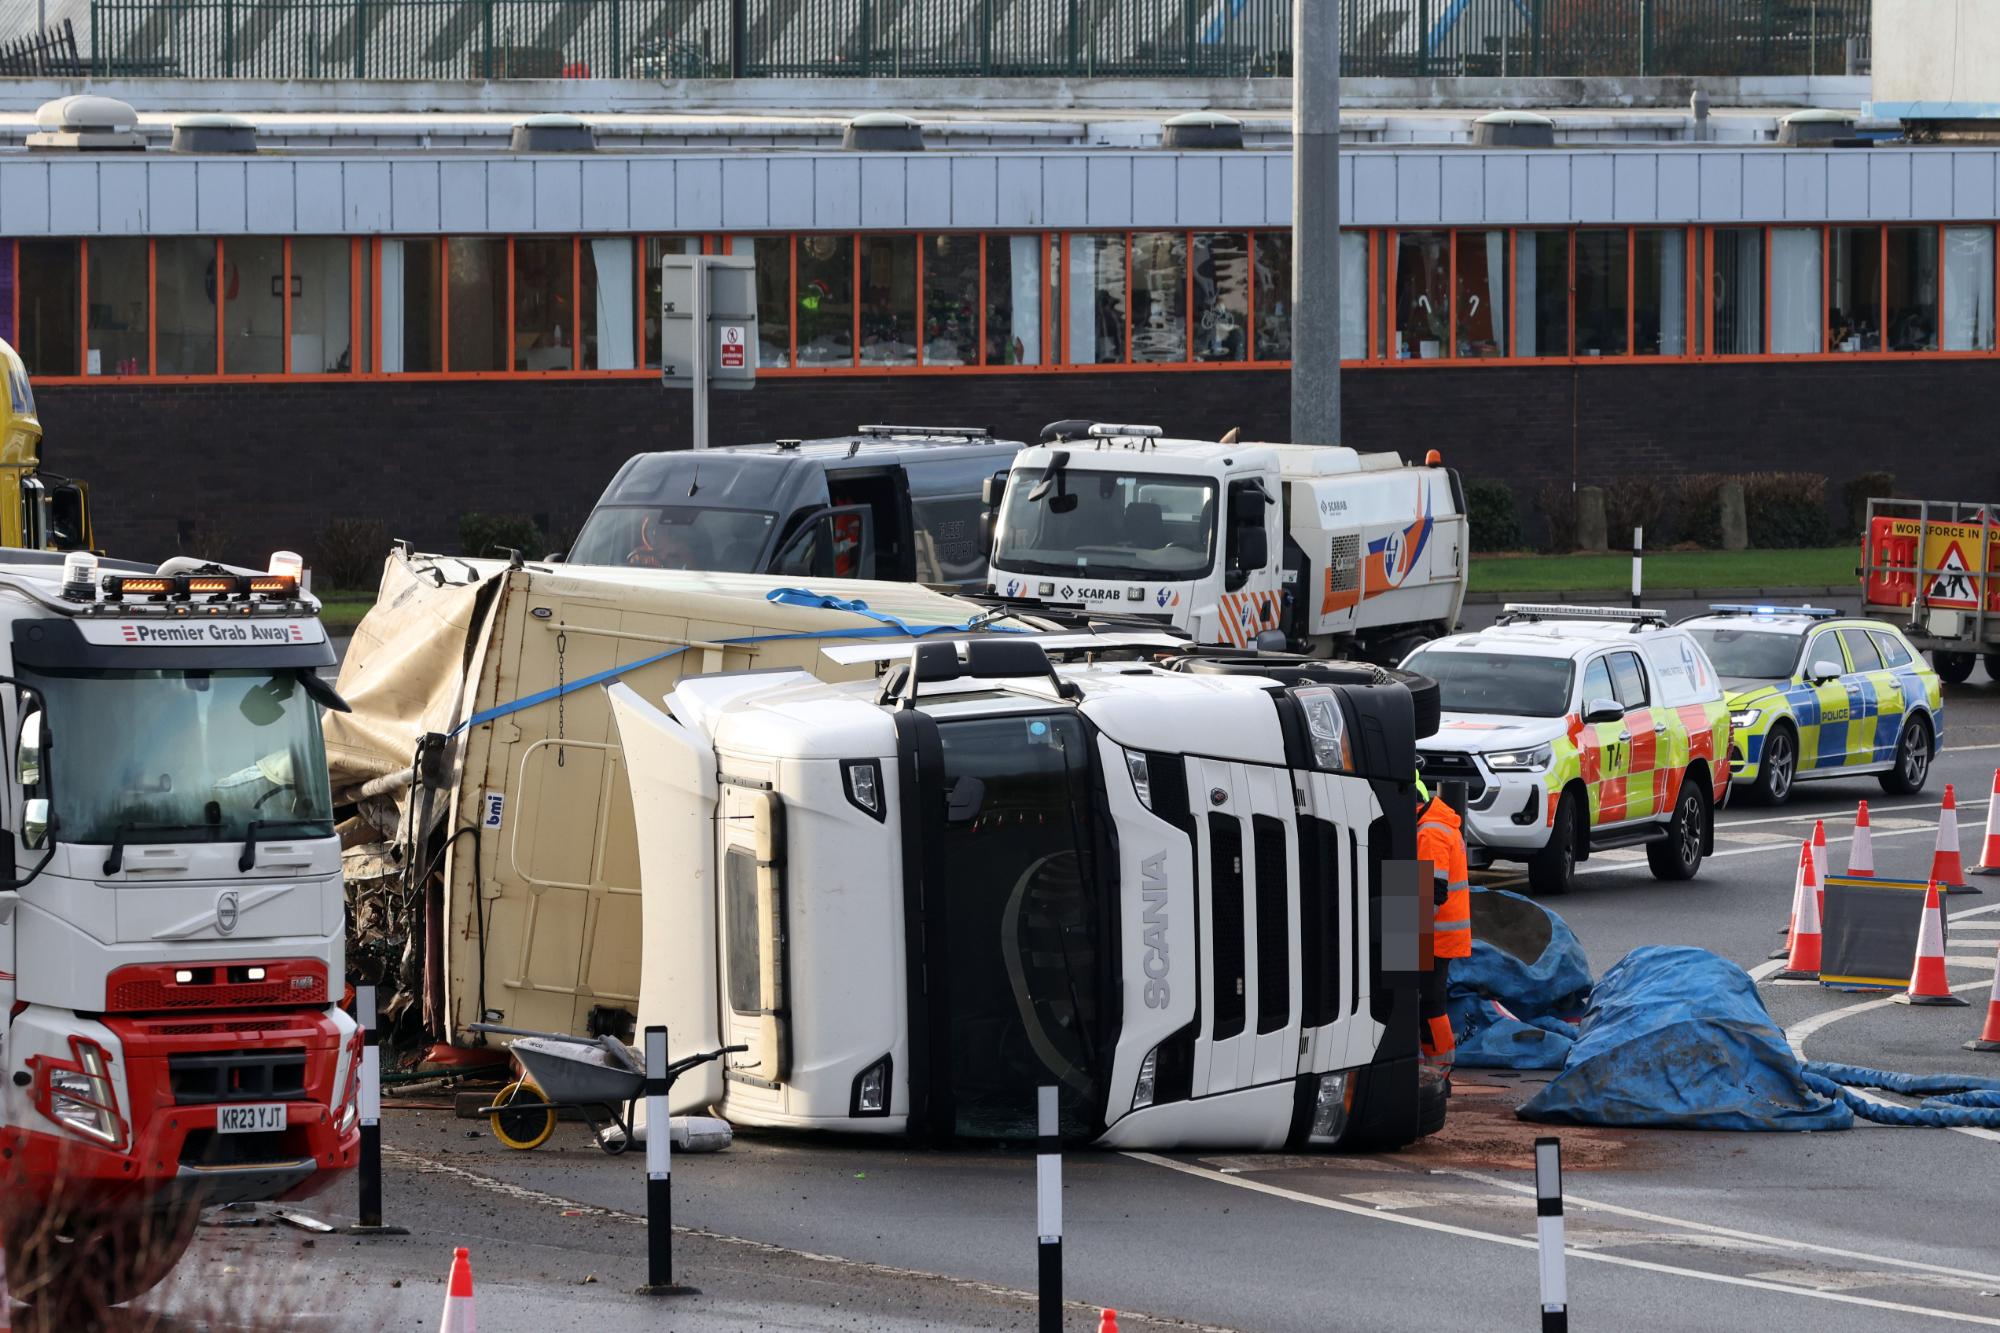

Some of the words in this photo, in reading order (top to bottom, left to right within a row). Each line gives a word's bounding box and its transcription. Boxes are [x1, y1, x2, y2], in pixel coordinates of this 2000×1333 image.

[939, 521, 965, 539] FLEET
[1968, 529, 1980, 539] IN
[1078, 587, 1121, 600] SCARAB
[137, 624, 206, 641] Premier
[208, 624, 247, 640] Grab
[251, 625, 290, 642] Away
[1822, 709, 1849, 721] POLICE
[1606, 743, 1622, 771] T4
[486, 795, 502, 825] bmi
[1141, 848, 1171, 1010] SCANIA
[222, 1108, 255, 1129] KR23
[258, 1107, 281, 1128] YJT
